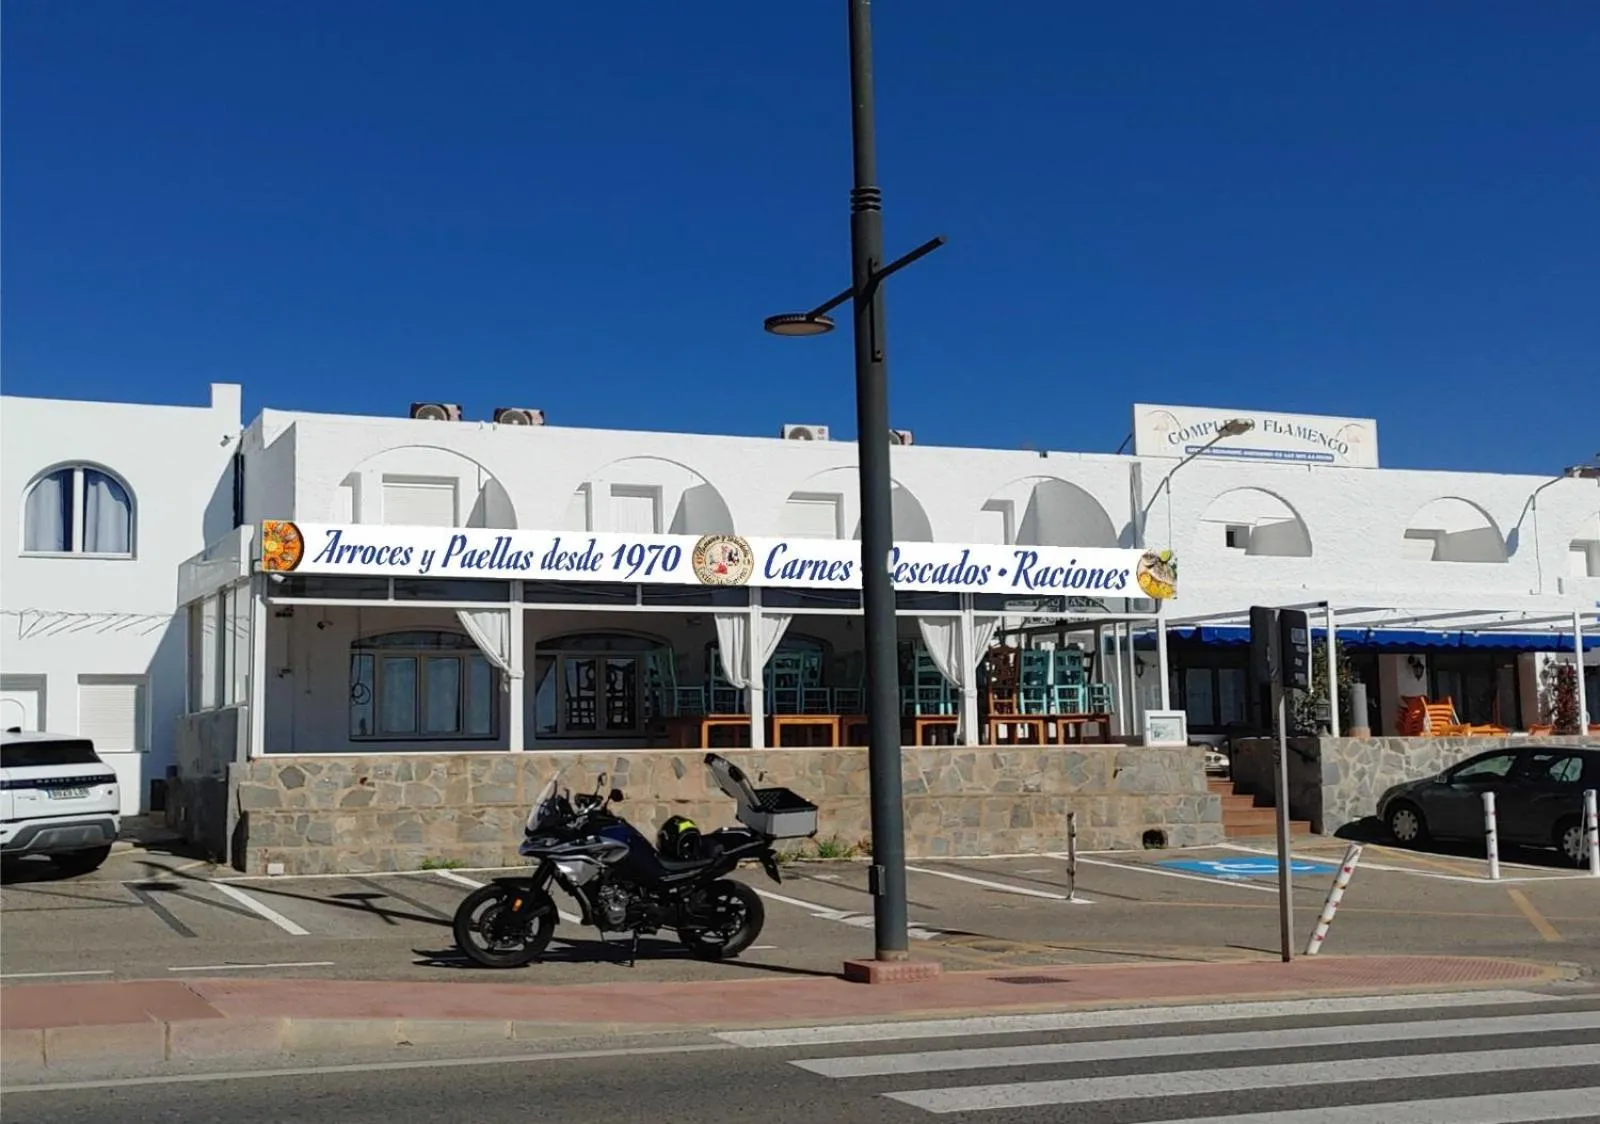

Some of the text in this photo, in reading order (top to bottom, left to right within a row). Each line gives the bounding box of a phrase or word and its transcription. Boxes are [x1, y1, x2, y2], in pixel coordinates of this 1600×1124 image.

[1263, 419, 1349, 455] FLAMENCO
[313, 530, 414, 568] Arroces
[418, 549, 436, 575] y
[442, 534, 532, 571] Paellas
[540, 538, 604, 572] desde
[612, 544, 681, 579] 1970
[764, 543, 854, 582] Carnes
[1011, 550, 1131, 592] Raciones
